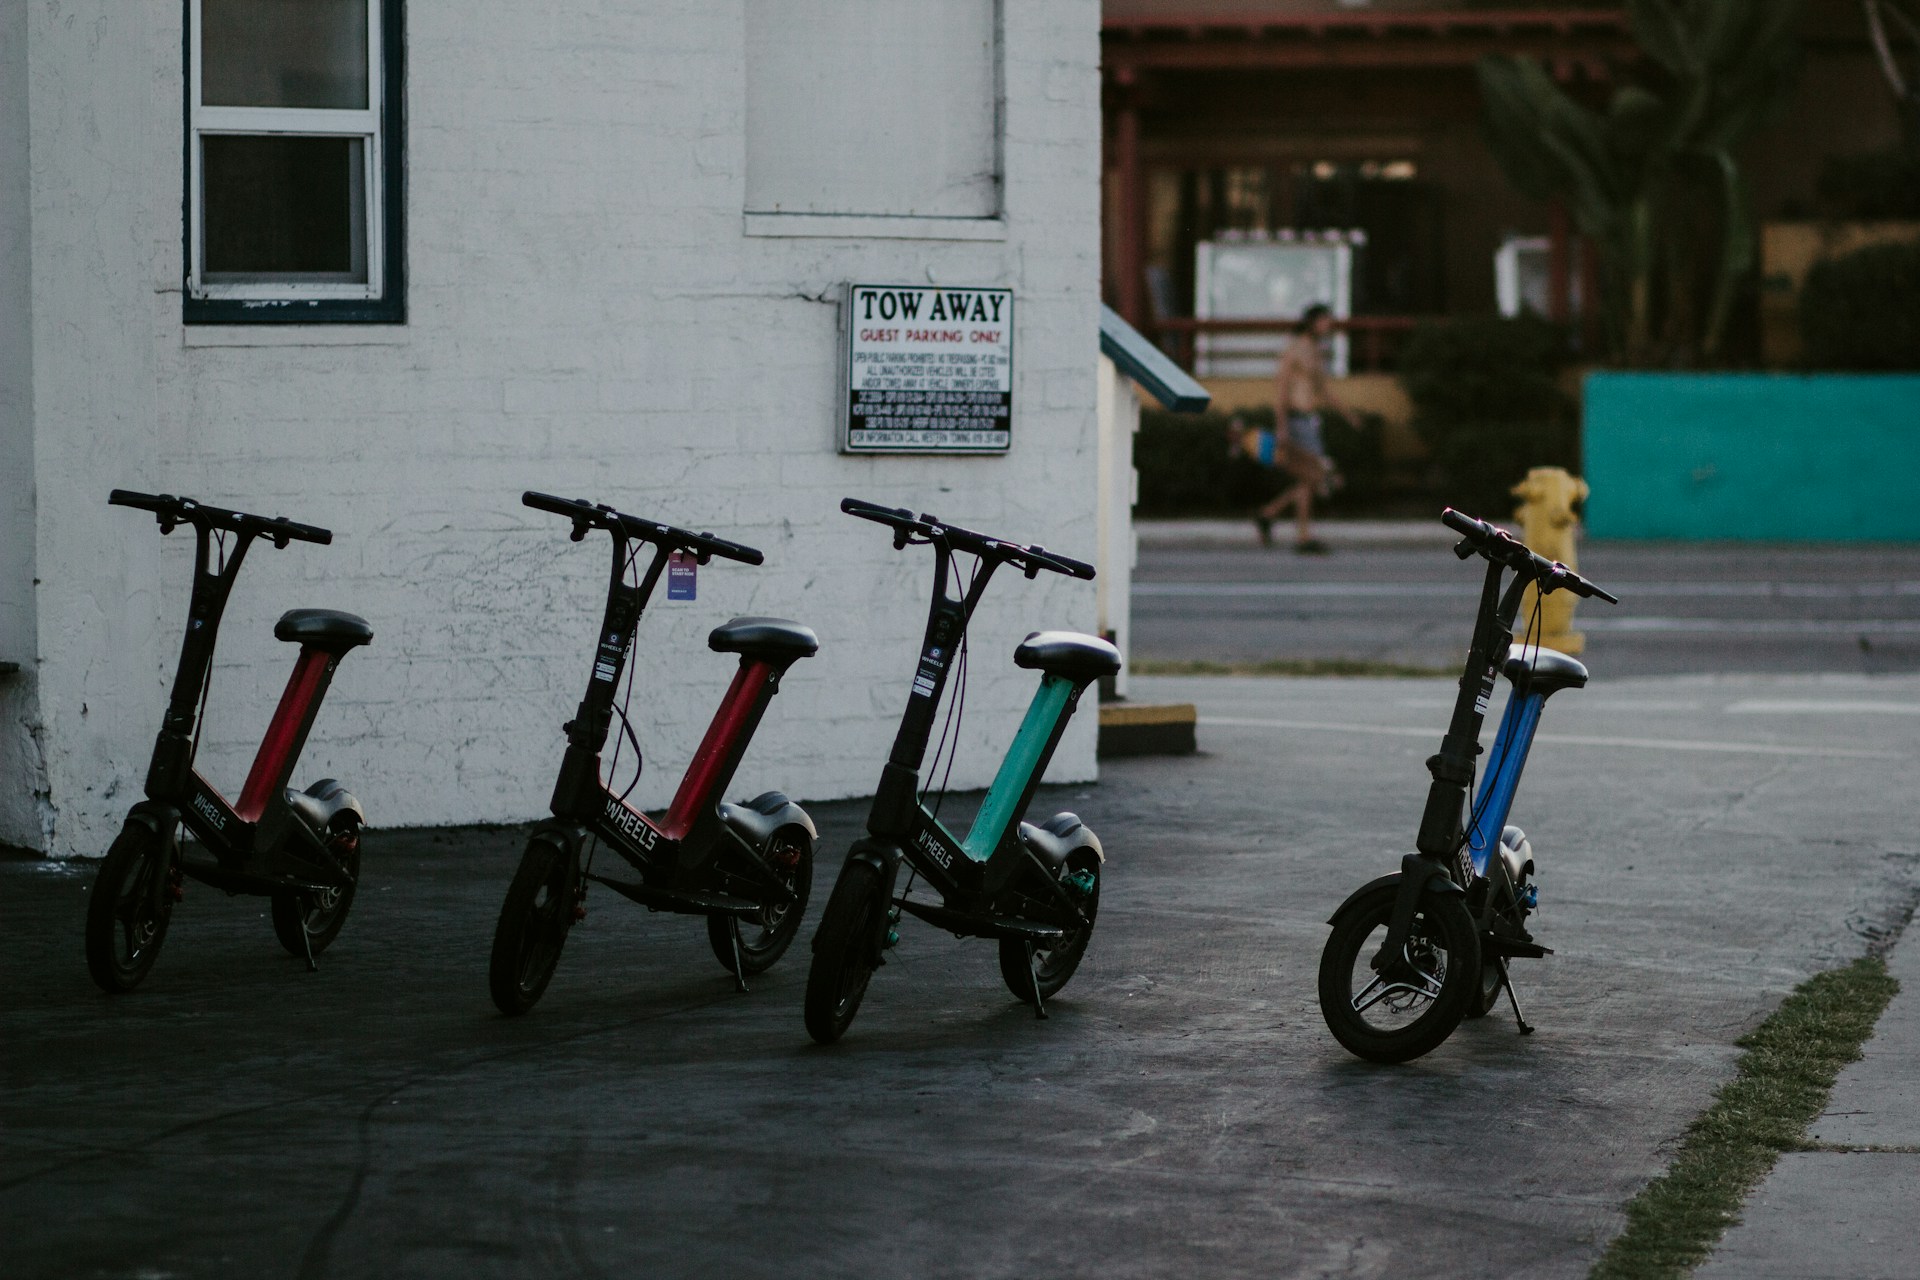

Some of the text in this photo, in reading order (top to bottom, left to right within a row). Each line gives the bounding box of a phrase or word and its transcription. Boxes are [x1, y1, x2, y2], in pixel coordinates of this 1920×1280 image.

[860, 291, 1005, 322] TOW AWAY
[860, 328, 1001, 343] GUEST PARKING ONLY
[600, 641, 623, 653] WHEELS
[921, 655, 944, 668] WHEELS
[194, 792, 226, 830] WHEELS
[607, 799, 658, 851] WHEELS
[919, 828, 954, 870] WHEELS
